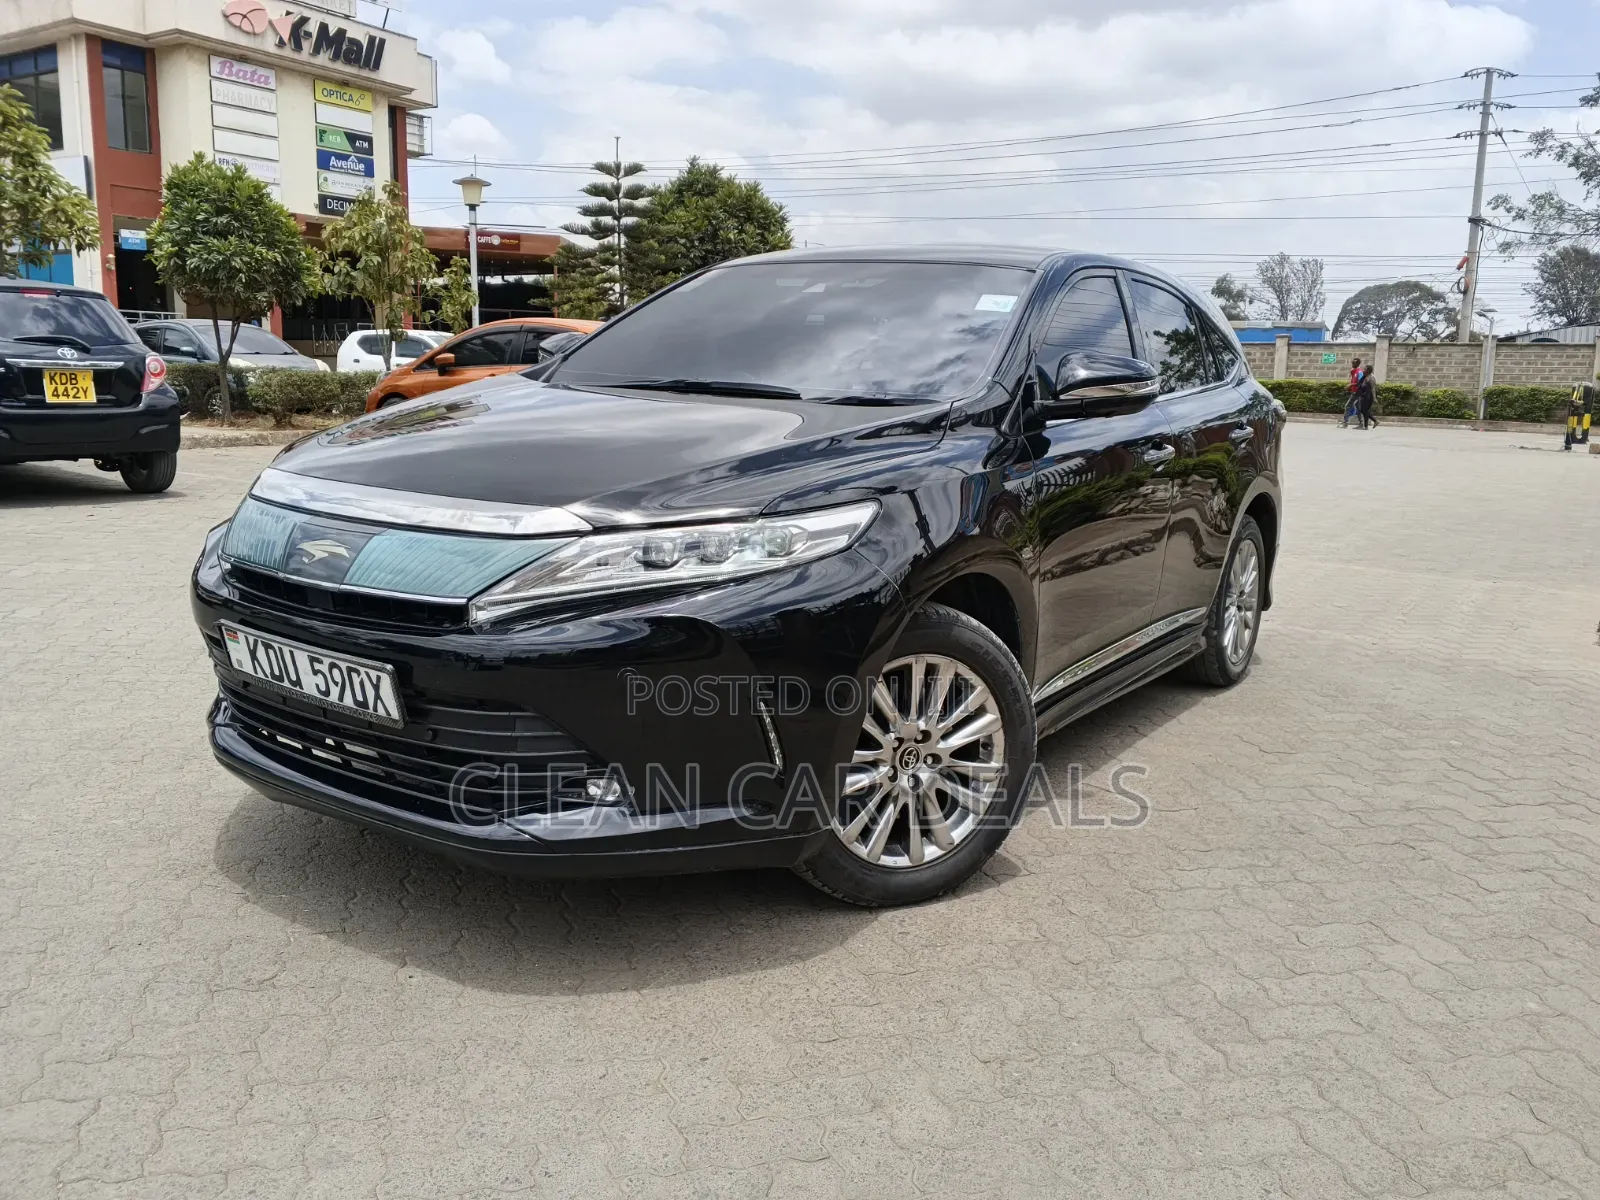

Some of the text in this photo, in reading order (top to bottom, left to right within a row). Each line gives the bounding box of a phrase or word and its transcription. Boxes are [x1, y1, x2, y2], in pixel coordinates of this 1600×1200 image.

[275, 10, 387, 72] K-Mall
[216, 60, 271, 86] Bata
[215, 88, 273, 111] PHARMACY
[321, 87, 354, 103] OPTICA
[328, 134, 369, 149] KCB ATM
[329, 155, 365, 171] Avenue
[49, 371, 79, 386] KDB
[51, 386, 89, 400] 442Y
[243, 634, 392, 717] KDU 590X
